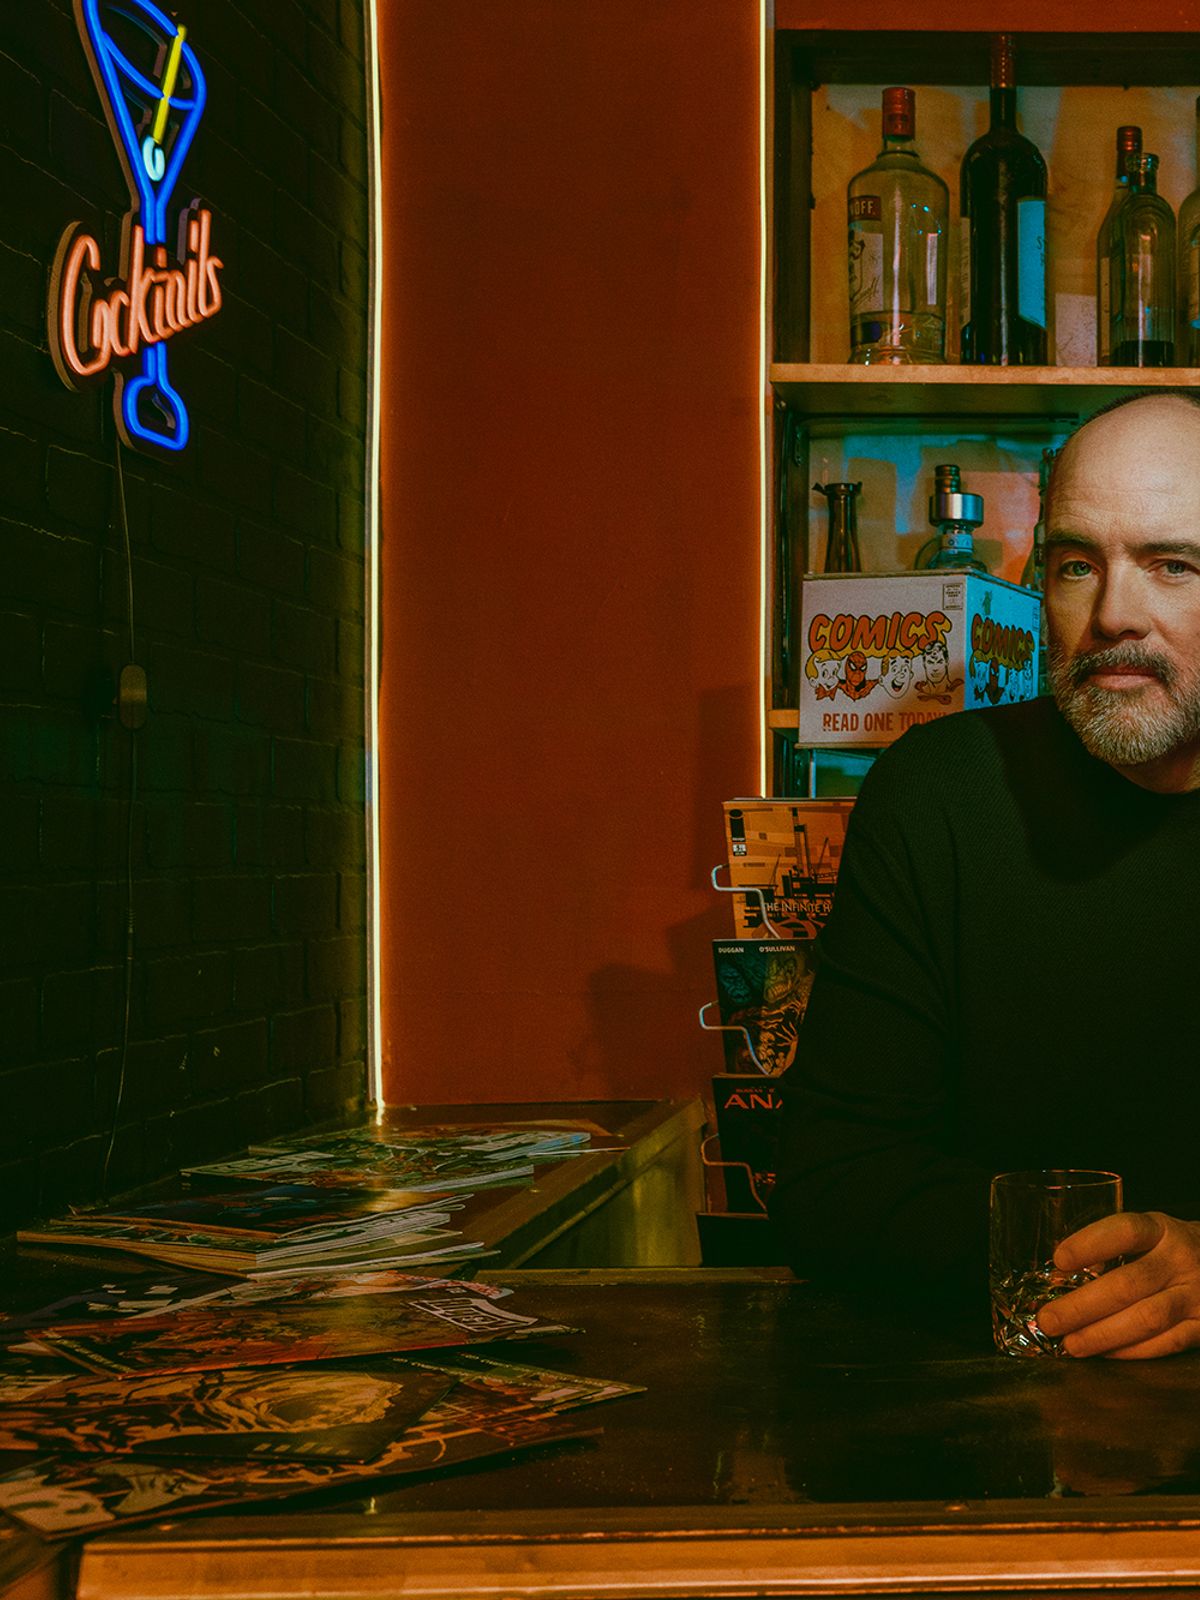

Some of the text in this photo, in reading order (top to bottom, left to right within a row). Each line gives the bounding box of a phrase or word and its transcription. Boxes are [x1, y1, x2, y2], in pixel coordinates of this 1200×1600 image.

[63, 208, 224, 375] Cocktails
[809, 611, 952, 655] COMICS
[971, 612, 1035, 665] COMICS
[823, 711, 947, 732] READ ONE TOD
[759, 946, 796, 954] O'SULLIVAN
